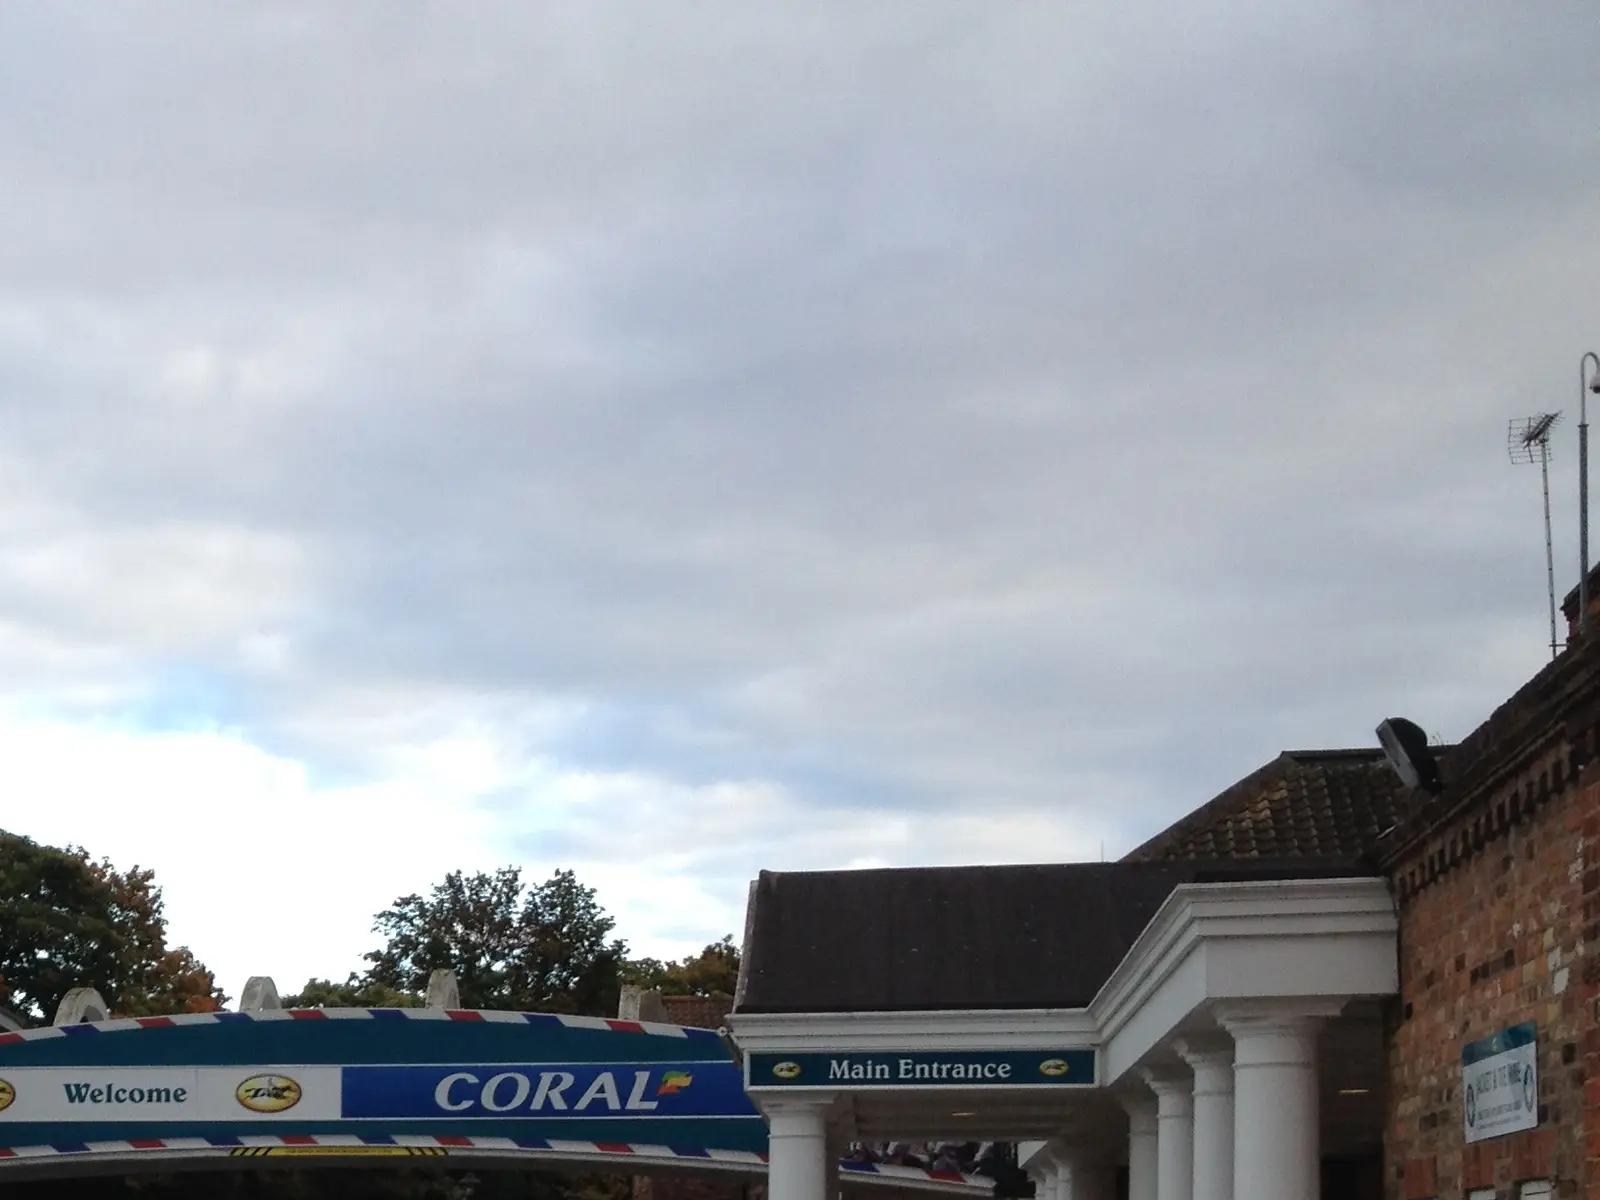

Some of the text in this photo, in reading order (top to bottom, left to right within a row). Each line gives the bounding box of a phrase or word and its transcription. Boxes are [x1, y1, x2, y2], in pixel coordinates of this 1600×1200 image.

[828, 1057, 1012, 1080] Main Entrance
[63, 1082, 188, 1104] Welcome
[434, 1070, 660, 1112] CORAL
